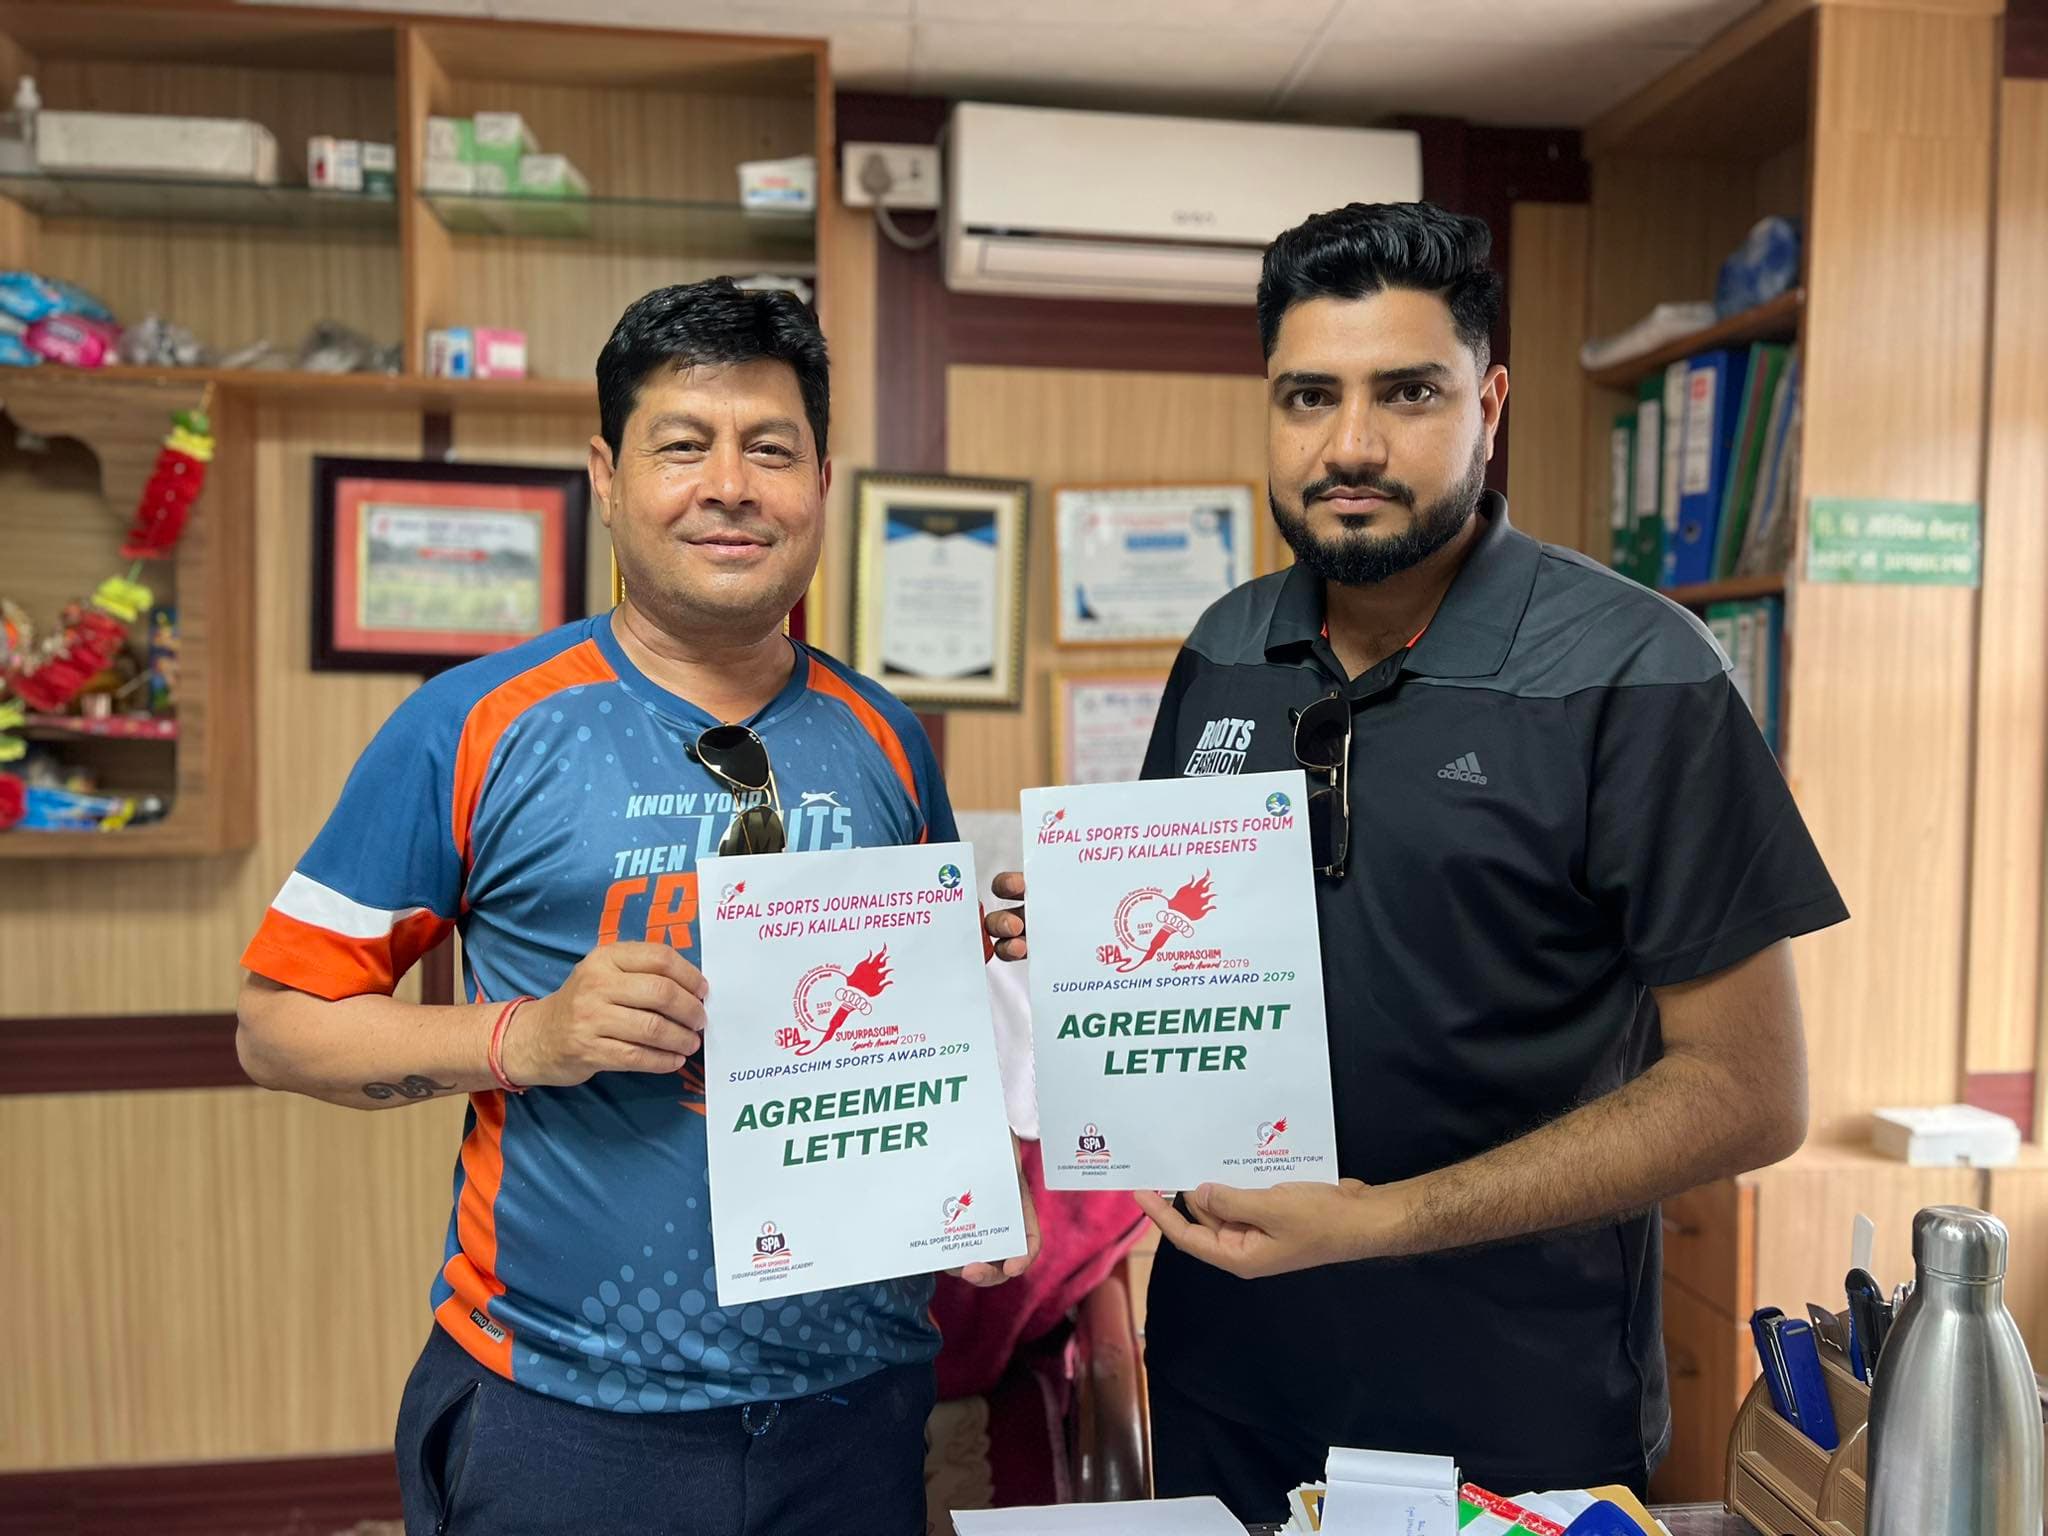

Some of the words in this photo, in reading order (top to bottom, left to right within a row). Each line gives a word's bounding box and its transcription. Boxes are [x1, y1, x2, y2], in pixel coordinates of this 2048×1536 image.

[1437, 766, 1488, 785] adidas
[626, 793, 698, 818] KNOW
[702, 791, 763, 813] YOUR
[1038, 826, 1082, 845] NEPAL
[1086, 825, 1139, 842] SPORTS
[1142, 820, 1238, 840] JOURNALISTS
[1242, 815, 1294, 832] FORUM
[614, 844, 687, 879] THEN
[1078, 848, 1124, 864] (NSJF)
[1128, 843, 1182, 859] KAILALI
[1186, 838, 1258, 856] PRESENTS
[716, 902, 762, 921] NEPAL
[766, 898, 820, 917] SPORTS
[822, 891, 913, 912] JOURNALISTS
[916, 886, 964, 904] FORUM
[758, 920, 804, 940] (NSJF)
[808, 914, 861, 934] KAILALI
[864, 910, 932, 930] PRESENTS
[1096, 944, 1122, 964] SPA
[1156, 948, 1222, 962] SUDURPASCHIM
[1223, 958, 1250, 969] 2079
[1052, 978, 1152, 994] SUDURPASCHIM
[1156, 974, 1206, 988] SPORTS
[1208, 972, 1260, 984] AWARD
[1262, 970, 1296, 983] 2079
[836, 1025, 899, 1042] SUDURPASCHIM
[1057, 1004, 1292, 1040] AGREEMENT
[774, 1027, 801, 1048] SPA
[900, 1033, 926, 1045] 2079
[729, 1060, 831, 1082] SUDURPASCHIM
[835, 1053, 884, 1070] SPORTS
[888, 1048, 936, 1062] AWARD
[940, 1042, 970, 1056] 2079
[1104, 1044, 1248, 1076] LETTER
[732, 1075, 968, 1132] AGREEMENT
[782, 1120, 928, 1167] LETTER
[1084, 1138, 1100, 1150] SPA
[944, 1224, 976, 1234] ORGANIZER
[760, 1236, 780, 1252] SPA
[471, 1311, 488, 1326] PRO
[486, 1324, 504, 1338] DRY
